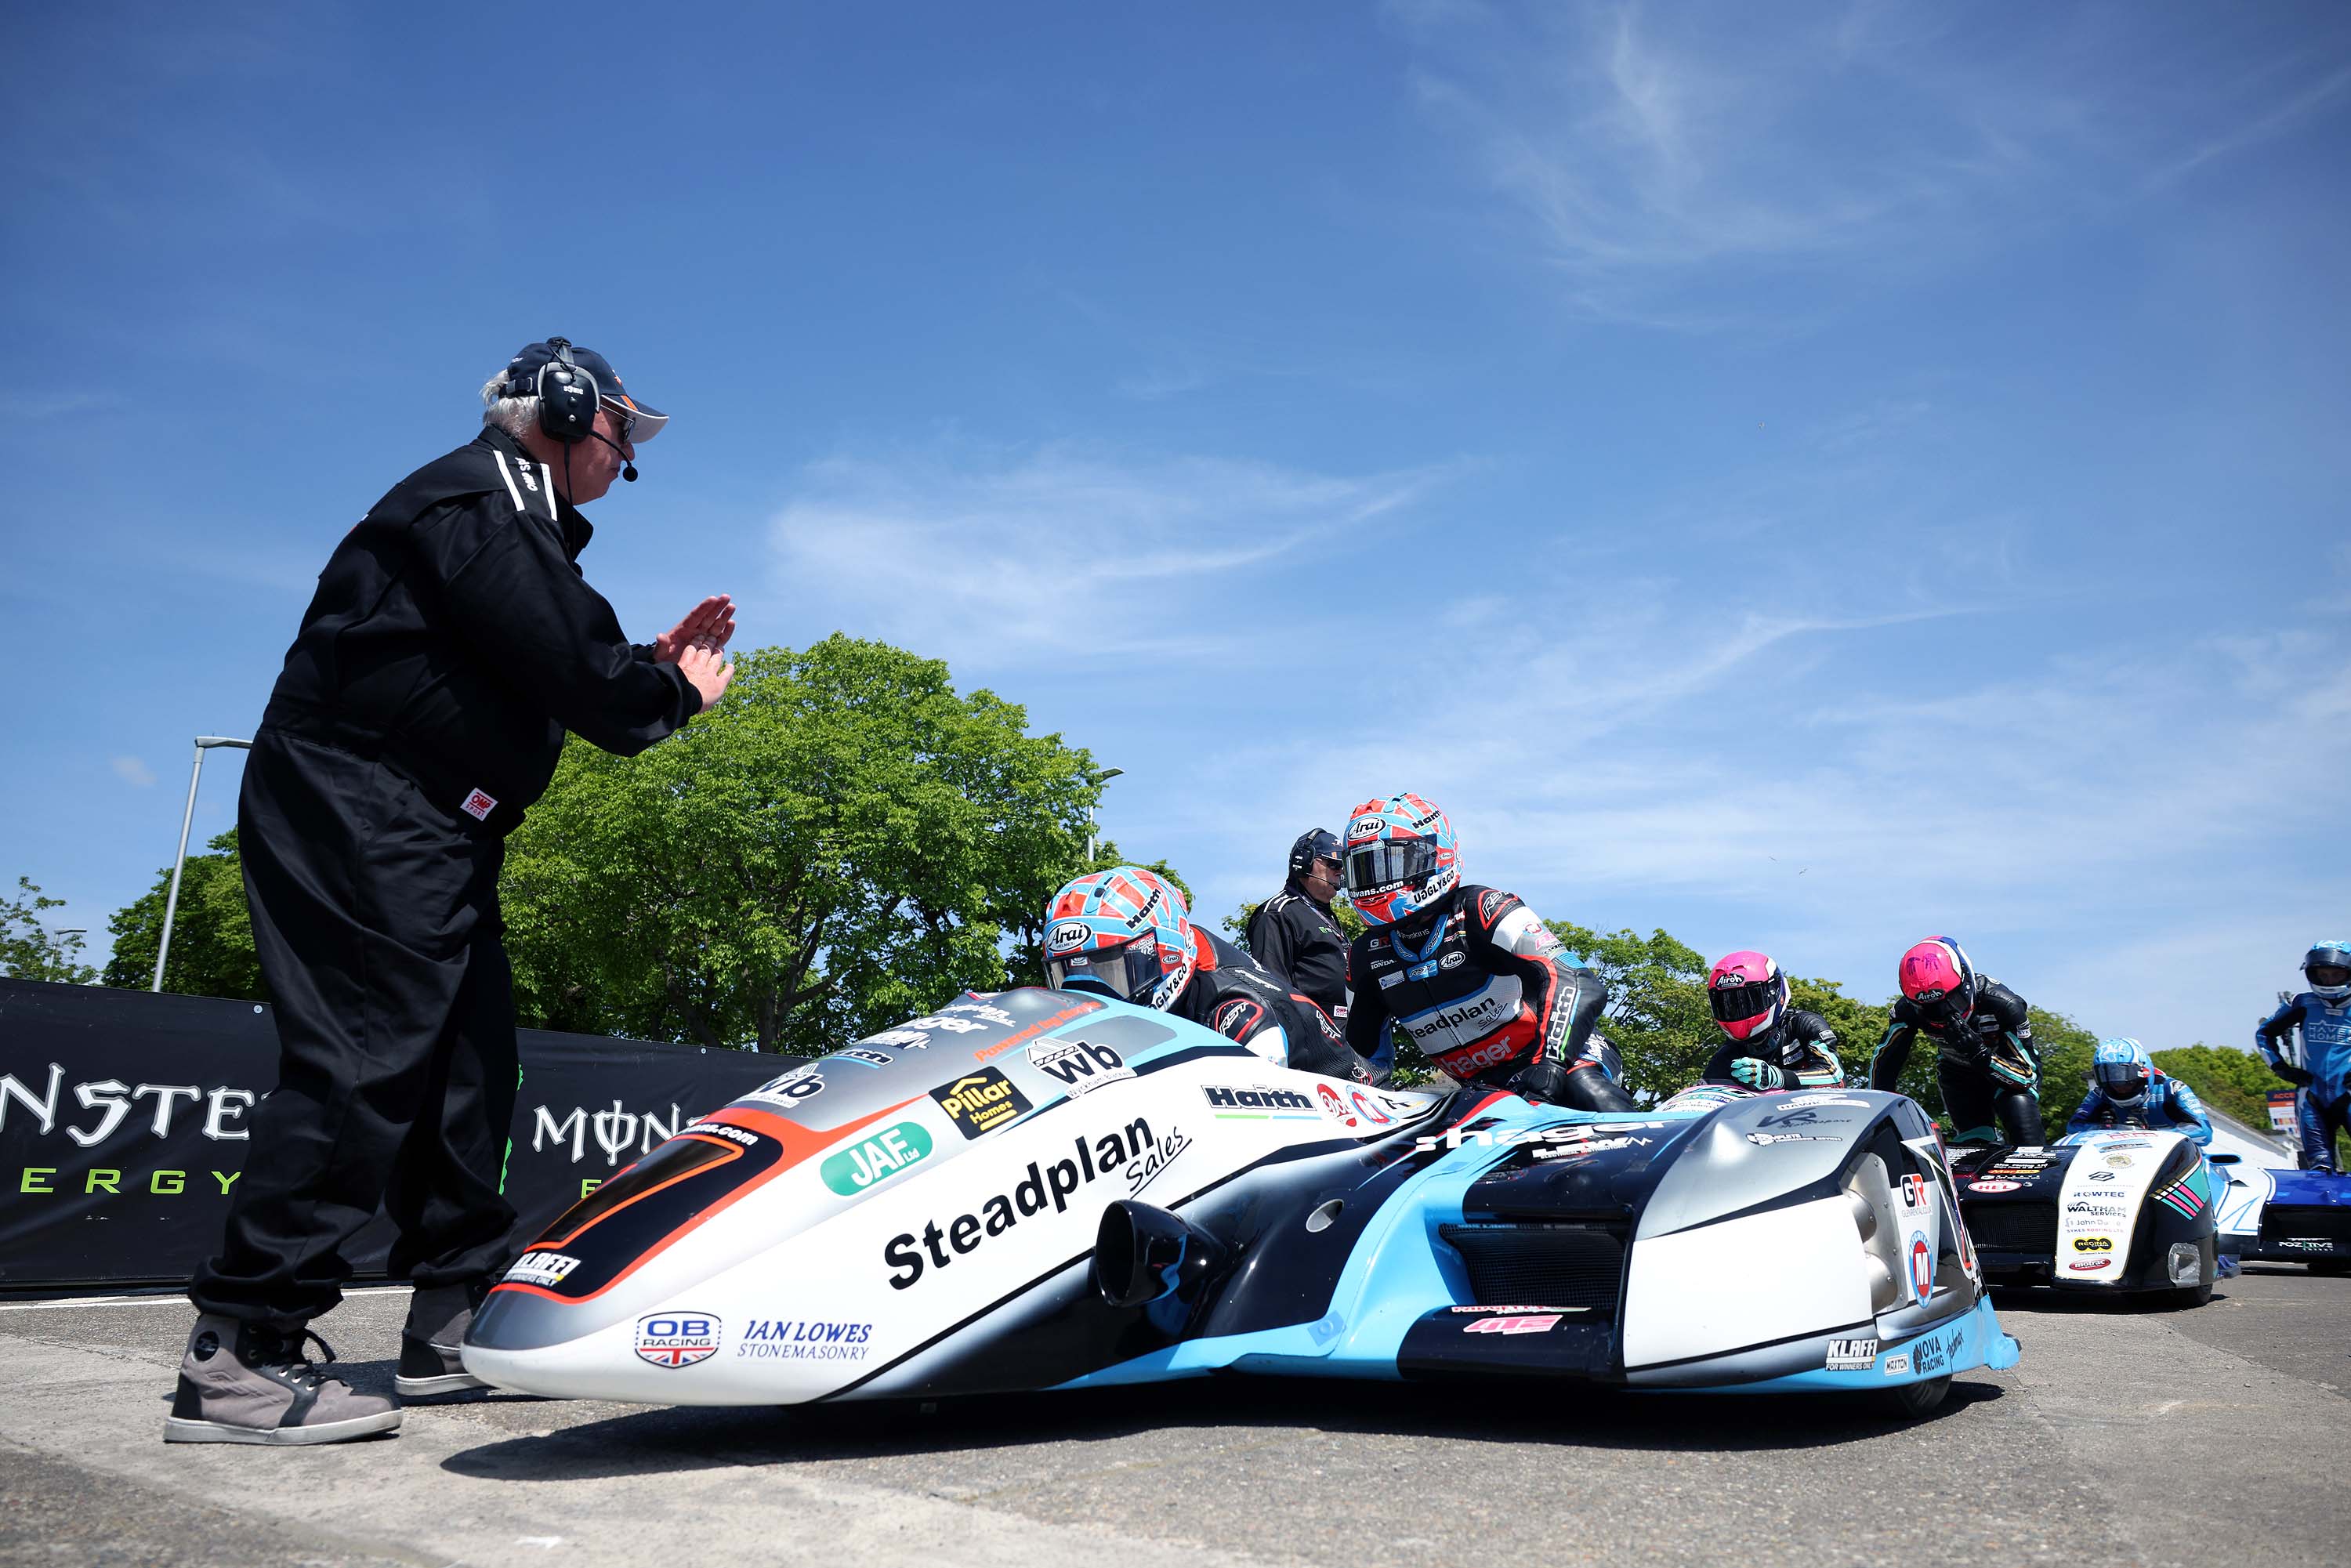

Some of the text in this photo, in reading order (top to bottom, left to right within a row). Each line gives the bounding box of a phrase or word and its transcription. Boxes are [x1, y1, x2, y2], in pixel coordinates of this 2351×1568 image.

[471, 795, 491, 809] OMP
[1352, 819, 1380, 834] Arai
[1052, 924, 1083, 946] Arai
[1717, 974, 1743, 986] Airoh
[1918, 990, 1943, 1001] Airoh
[2308, 1025, 2351, 1035] HAVE
[1442, 1034, 1512, 1075] hager
[941, 1078, 1012, 1120] Pillar
[1201, 1085, 1317, 1111] Haith
[969, 1100, 1013, 1125] Homes
[532, 1099, 709, 1167] MON
[849, 1128, 921, 1186] JAF Ltd
[1125, 1126, 1183, 1193] Sales
[1901, 1175, 1926, 1208] GR
[885, 1117, 1154, 1291] Steadplan
[1915, 1251, 1929, 1286] M
[2074, 1259, 2106, 1269] motrac
[647, 1320, 710, 1337] OB
[744, 1320, 872, 1343] IAN LOWES
[643, 1338, 711, 1347] RACING
[737, 1343, 870, 1360] STONEMASONRY
[1827, 1338, 1878, 1357] KLAFFI
[1886, 1358, 1908, 1372] MAXTON
[1922, 1355, 1944, 1374] RACING
